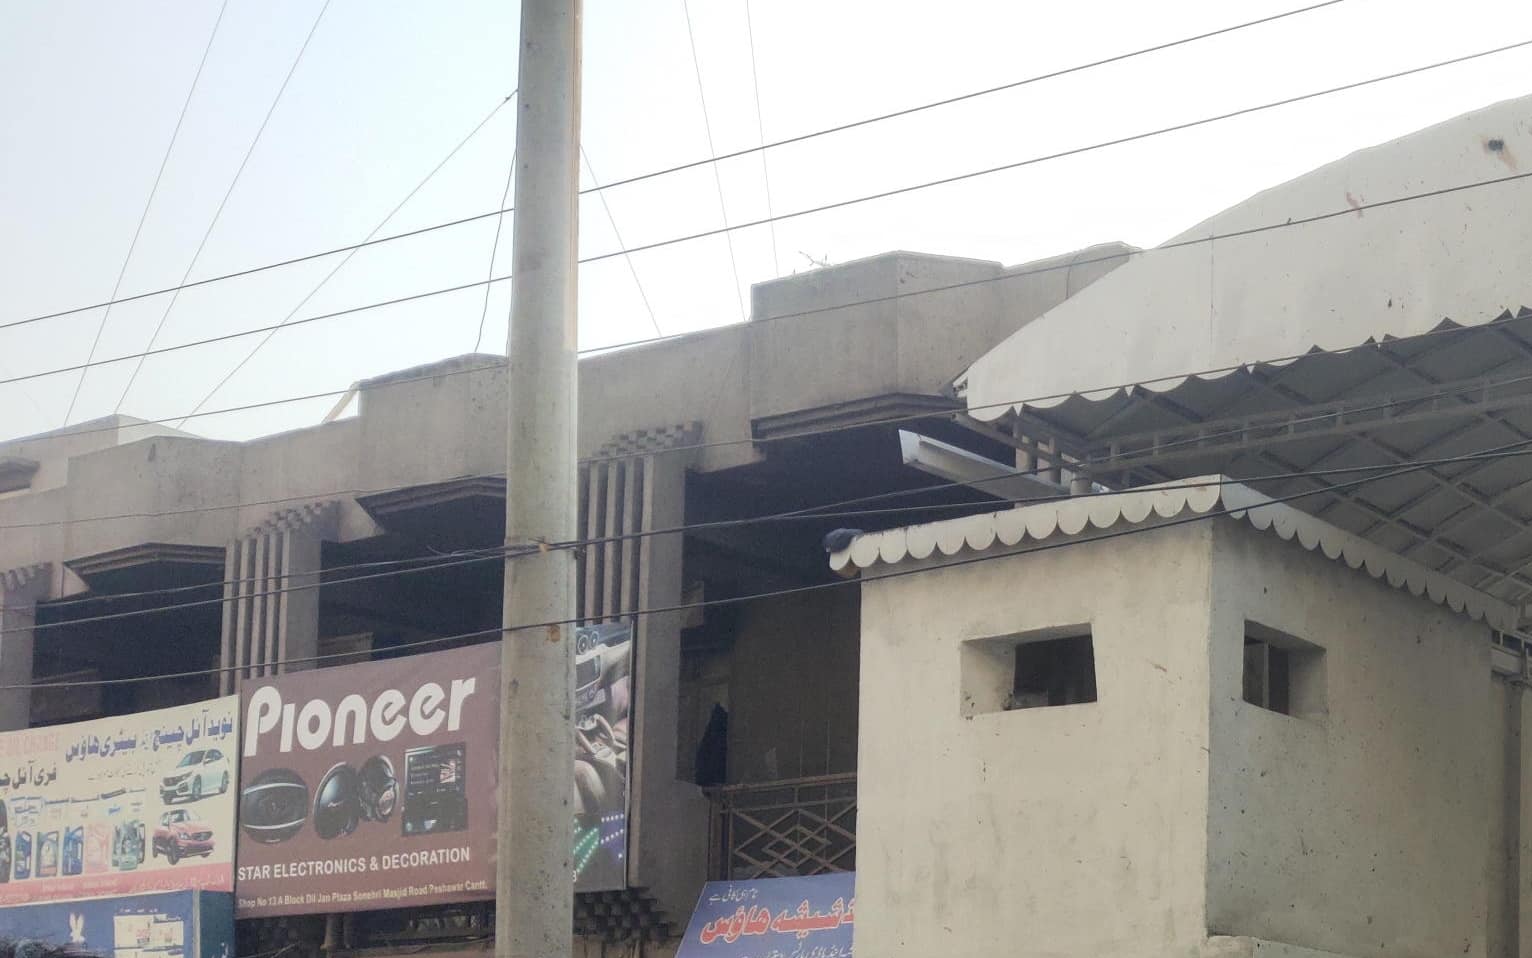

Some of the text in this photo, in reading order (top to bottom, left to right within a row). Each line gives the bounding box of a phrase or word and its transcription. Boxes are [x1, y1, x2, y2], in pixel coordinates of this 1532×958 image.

[243, 677, 476, 758] Pioneer
[238, 846, 470, 880] STAR ELECTRONICS & DECORATION
[284, 895, 305, 905] Block
[306, 893, 316, 904] Dil
[317, 893, 331, 904] Jan
[383, 887, 408, 899] Masjid
[409, 885, 428, 897] Road
